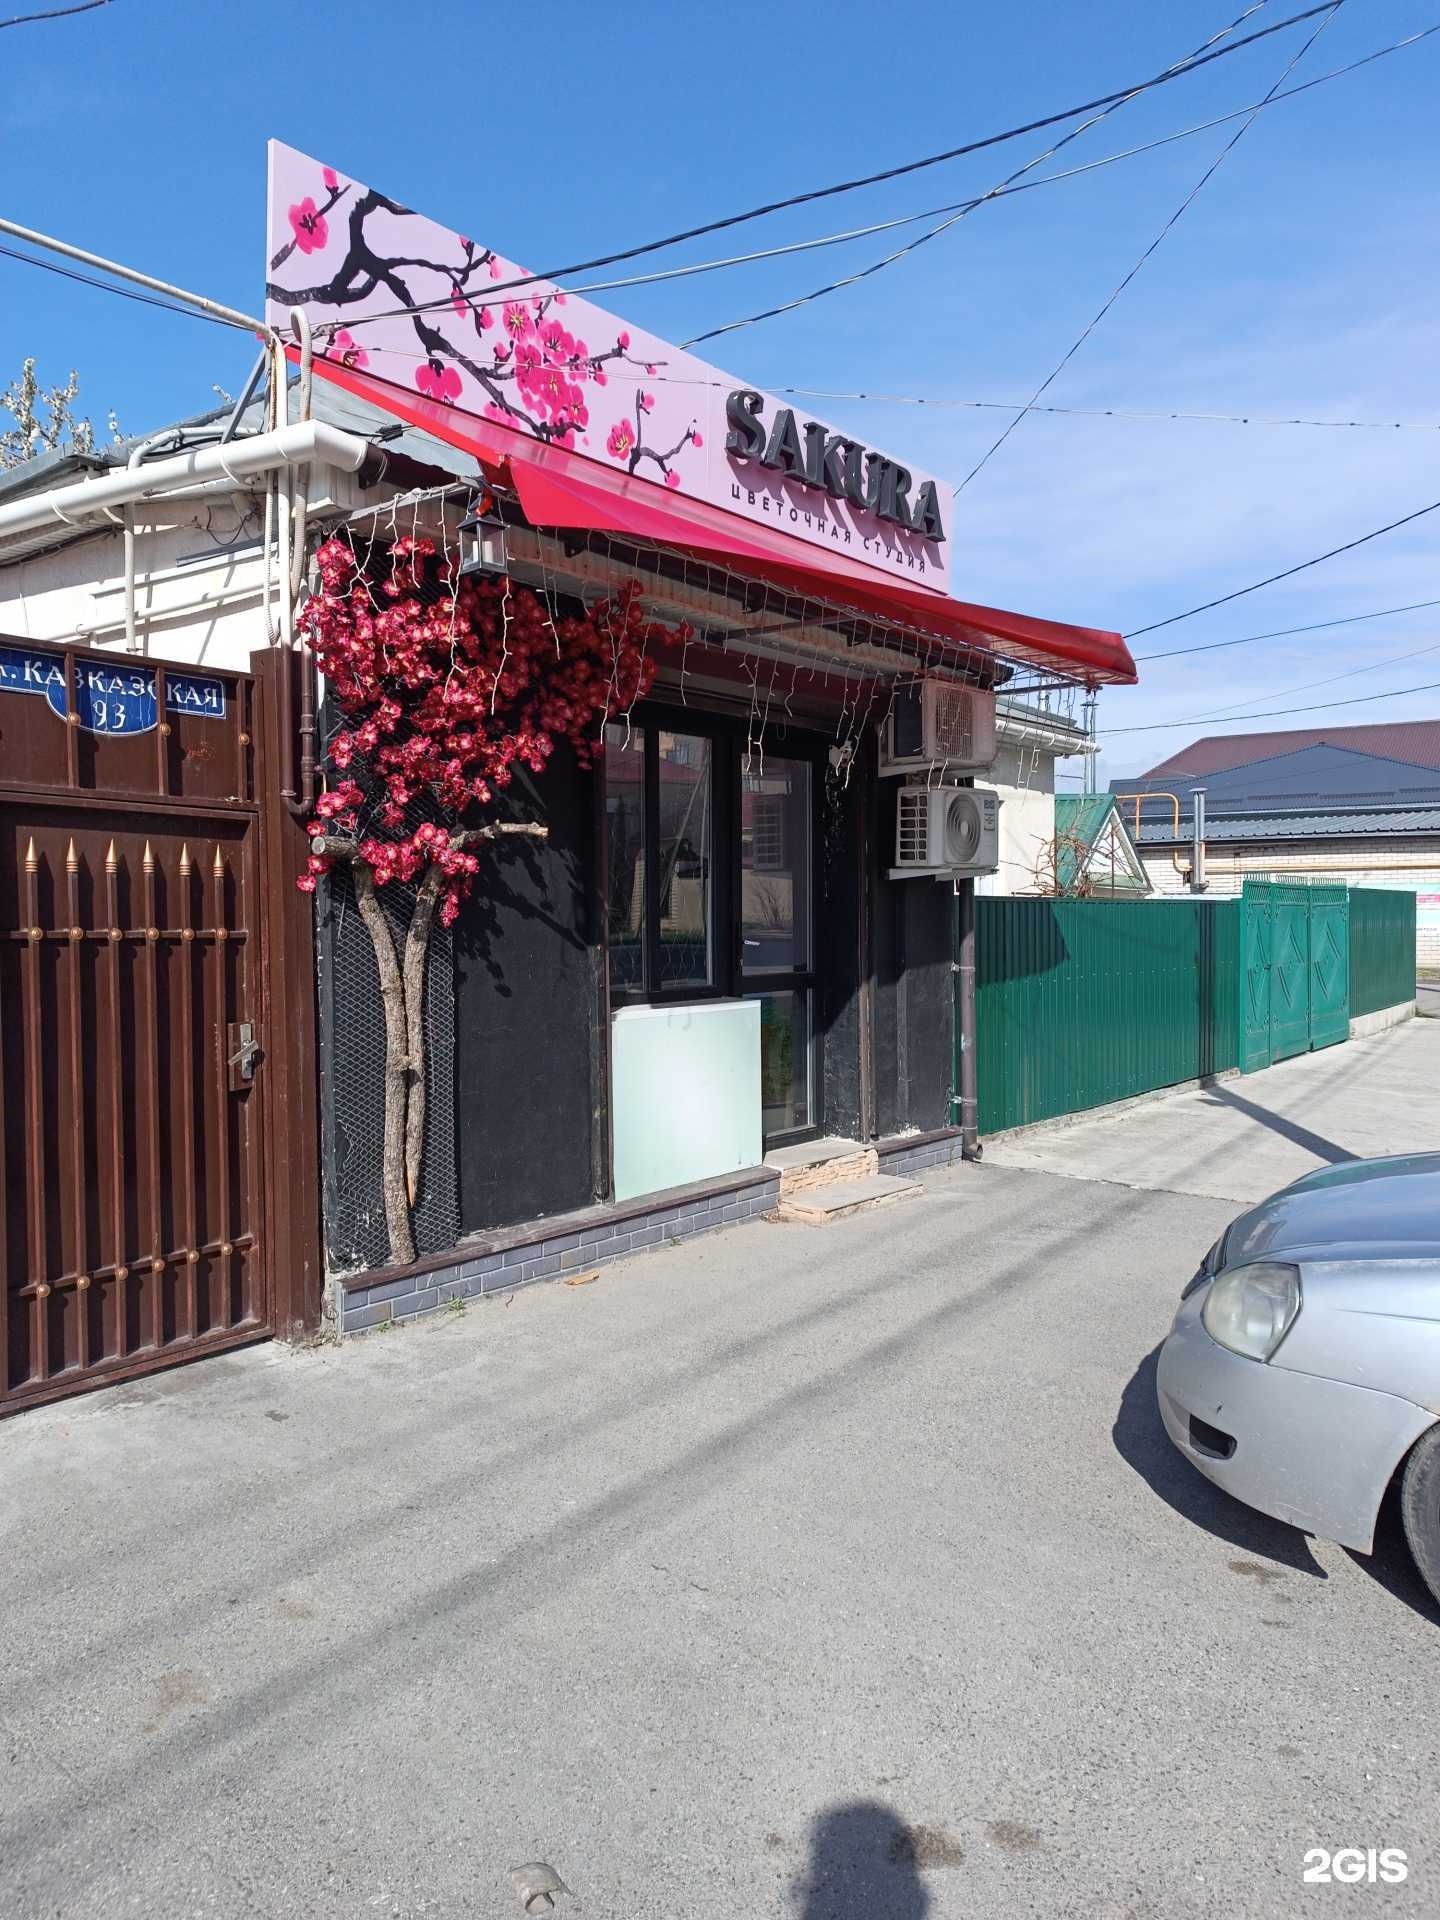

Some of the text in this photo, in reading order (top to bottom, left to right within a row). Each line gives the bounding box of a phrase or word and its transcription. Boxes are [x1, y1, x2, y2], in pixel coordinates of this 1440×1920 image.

[726, 389, 947, 543] SAKURA
[730, 483, 926, 573] ЦВЕТОЧНАЯ СТУДИЯ
[93, 699, 126, 729] 93
